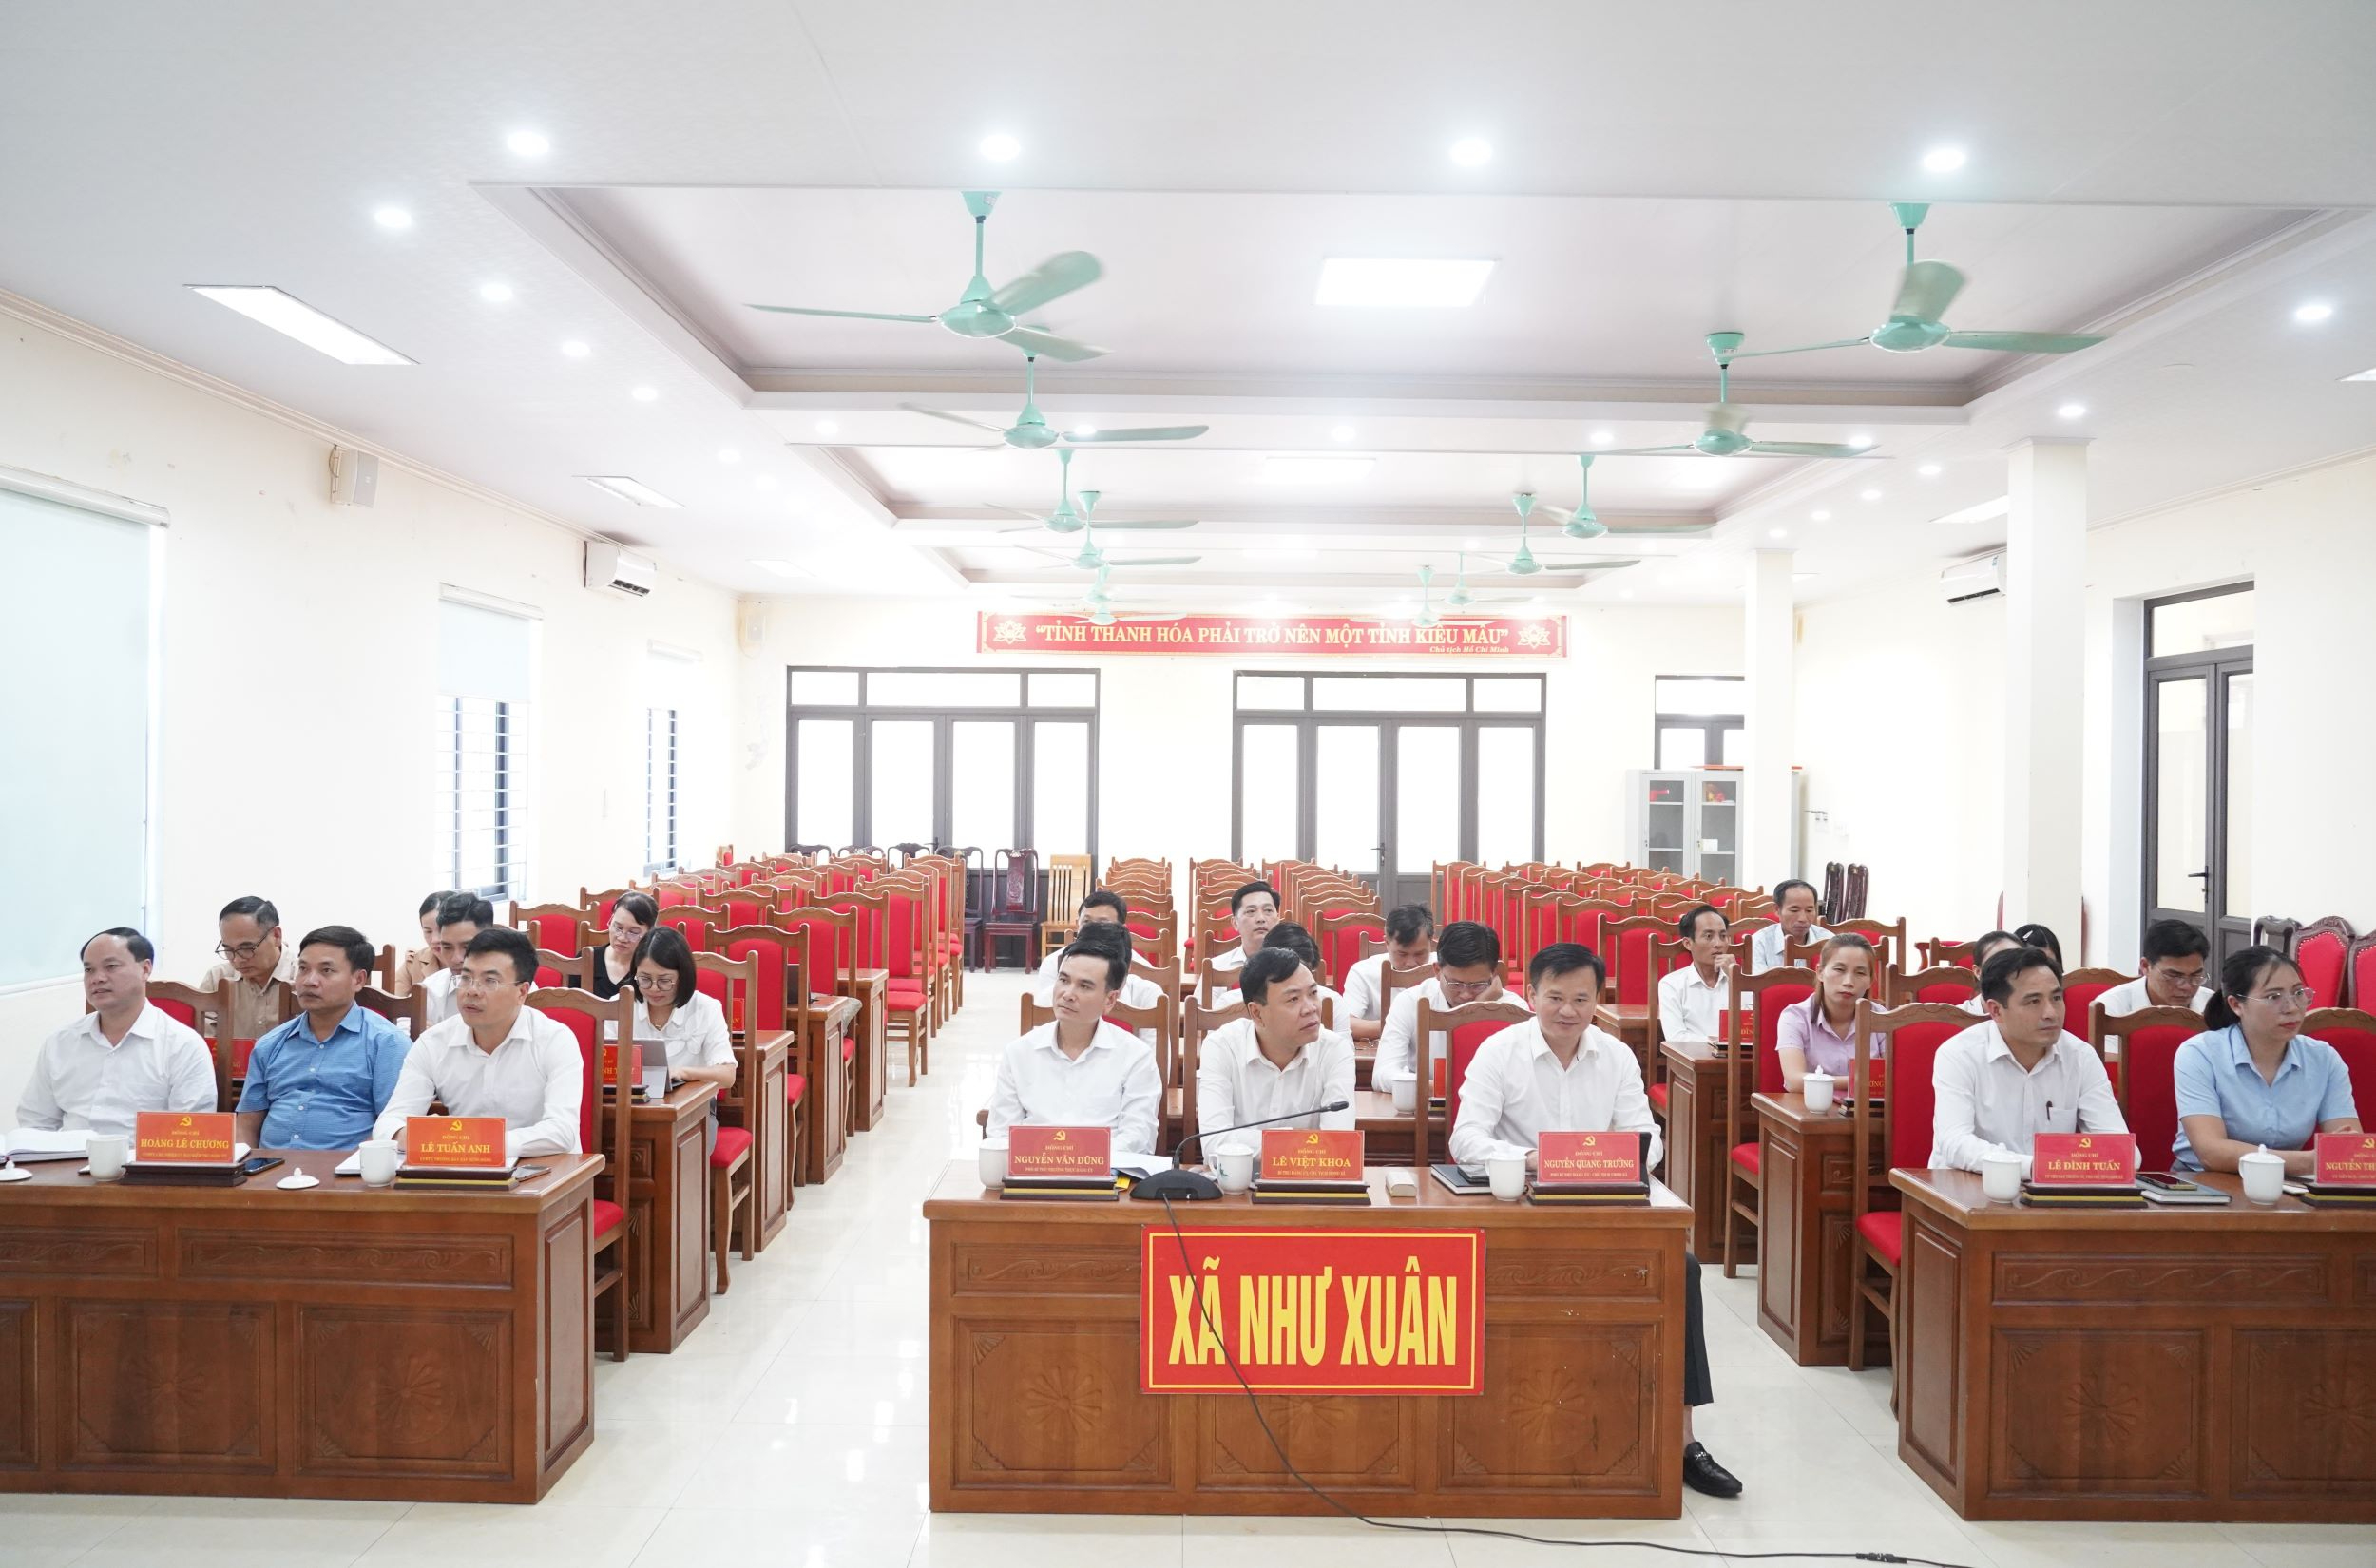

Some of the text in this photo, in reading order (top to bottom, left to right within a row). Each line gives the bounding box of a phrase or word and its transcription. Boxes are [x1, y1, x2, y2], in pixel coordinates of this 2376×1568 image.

[1090, 624, 1152, 642] THANH
[1157, 622, 1194, 642] HÓA
[1198, 621, 1240, 643] PHẢI
[1244, 621, 1280, 643] TRỞ
[1284, 623, 1320, 643] NÊN
[1325, 625, 1364, 648] MỘT
[1368, 621, 1413, 643] TỈNH
[1447, 645, 1461, 654] tịch
[141, 1137, 174, 1148] HOÀNG
[421, 1141, 490, 1154] LÊ TUẤN ANH
[1014, 1152, 1104, 1165] NGUYỄN VĂN DŨNG
[1273, 1156, 1351, 1169] LÊ VIỆT KHOA
[1544, 1157, 1635, 1170] NGUYỄN QUANG TRƯỜNG
[2048, 1159, 2121, 1170] LÊ ĐÌNH TUẤN
[2326, 1158, 2376, 1171] NGUYỄN TH
[1168, 1255, 1457, 1367] XÃ NHƯ XUÂN
